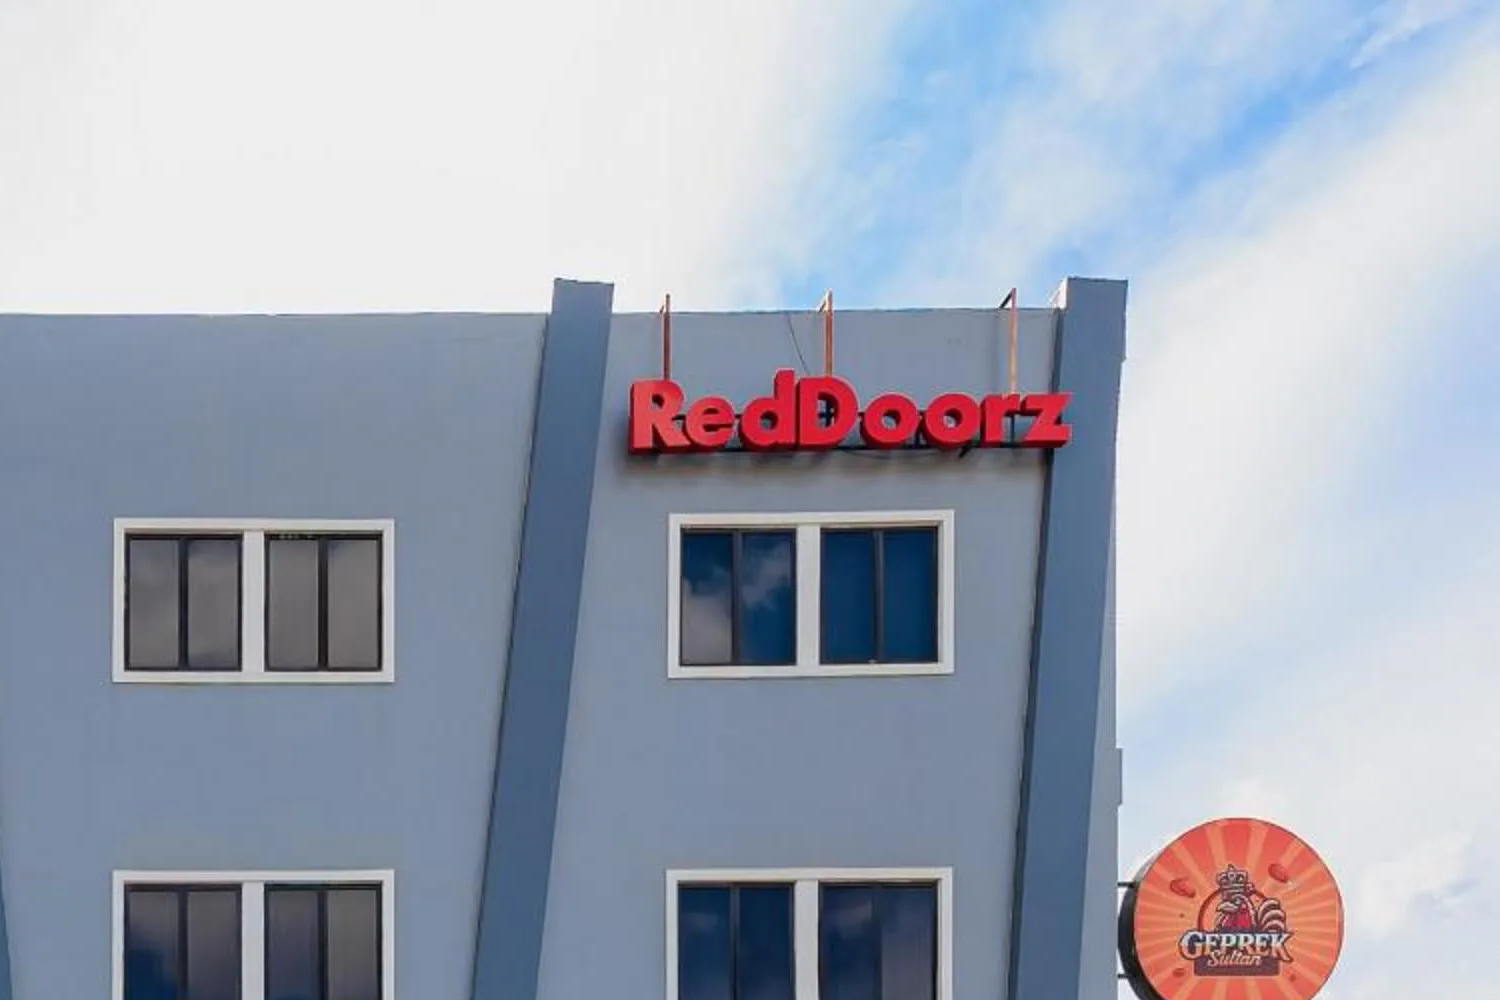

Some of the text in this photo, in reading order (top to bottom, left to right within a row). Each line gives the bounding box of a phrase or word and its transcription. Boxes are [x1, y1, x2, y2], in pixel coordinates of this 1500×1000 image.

[629, 368, 1072, 453] RedDoorz
[1179, 931, 1294, 962] GEPREK
[1207, 949, 1261, 967] Sultan
